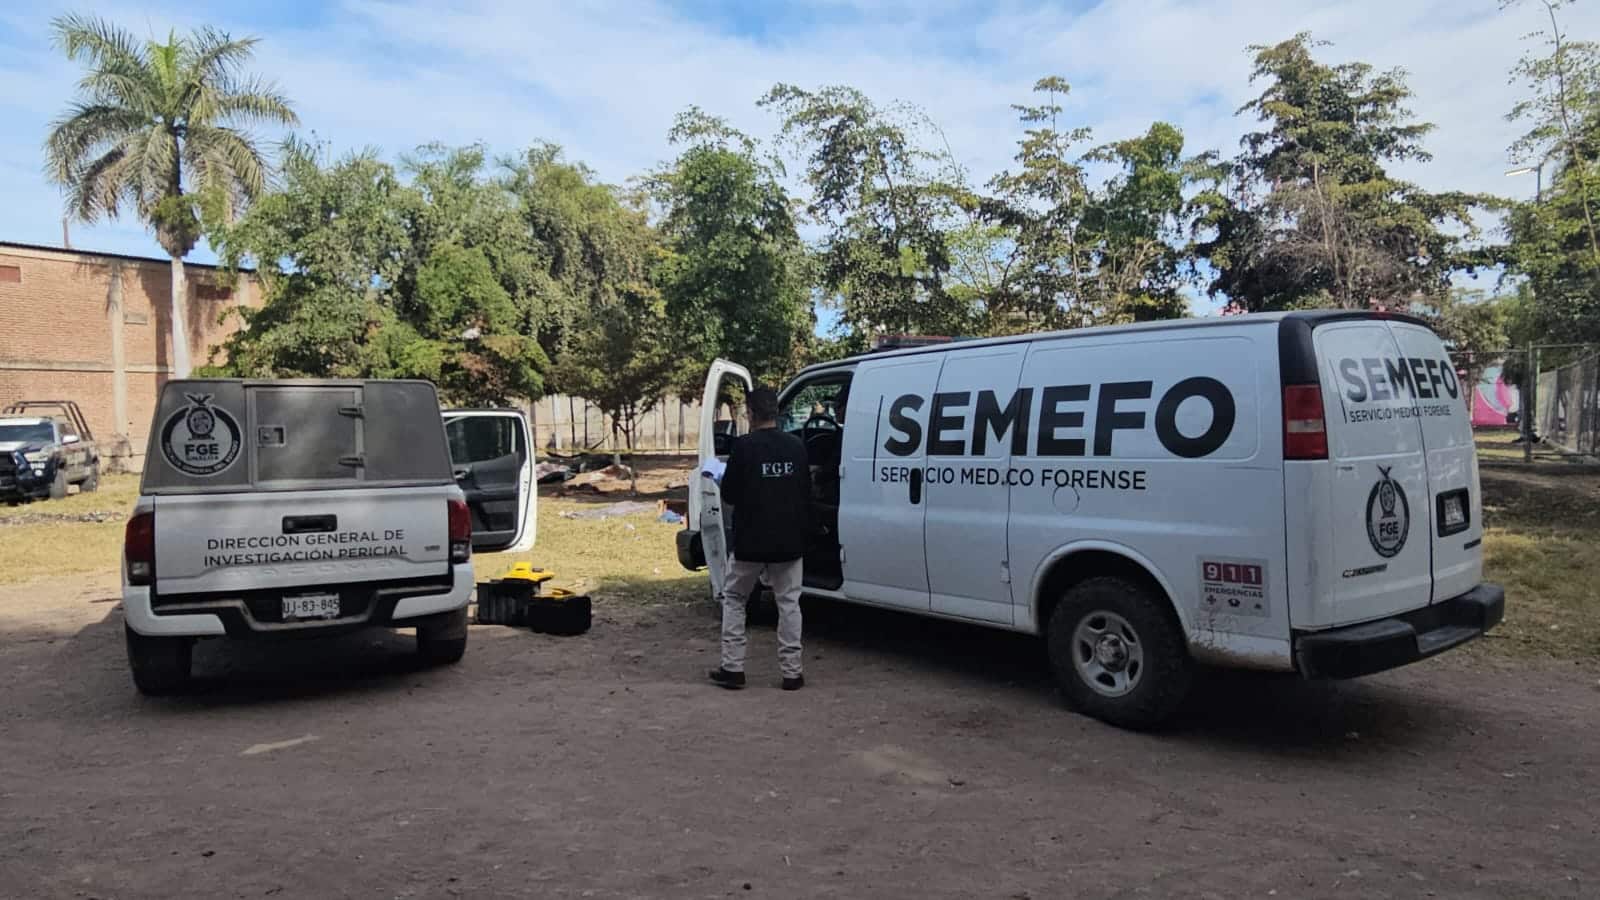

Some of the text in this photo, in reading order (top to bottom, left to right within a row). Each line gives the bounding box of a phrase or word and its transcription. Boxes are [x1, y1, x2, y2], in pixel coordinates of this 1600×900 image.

[1339, 358, 1458, 403] SEMEFO
[884, 376, 1236, 459] SEMEFO
[1350, 408, 1393, 423] SERVICIO
[184, 443, 219, 455] FGE
[761, 462, 794, 475] FGE
[880, 466, 955, 484] SERICIO
[1041, 468, 1147, 490] FORENSE
[1379, 521, 1399, 537] FGE
[207, 529, 405, 551] DIRECCIÓN GENERAL DE
[204, 545, 409, 567] INVESTIGACIÓN PERICIAL
[1206, 564, 1257, 583] 911
[1204, 586, 1264, 598] EMERGENCIAS
